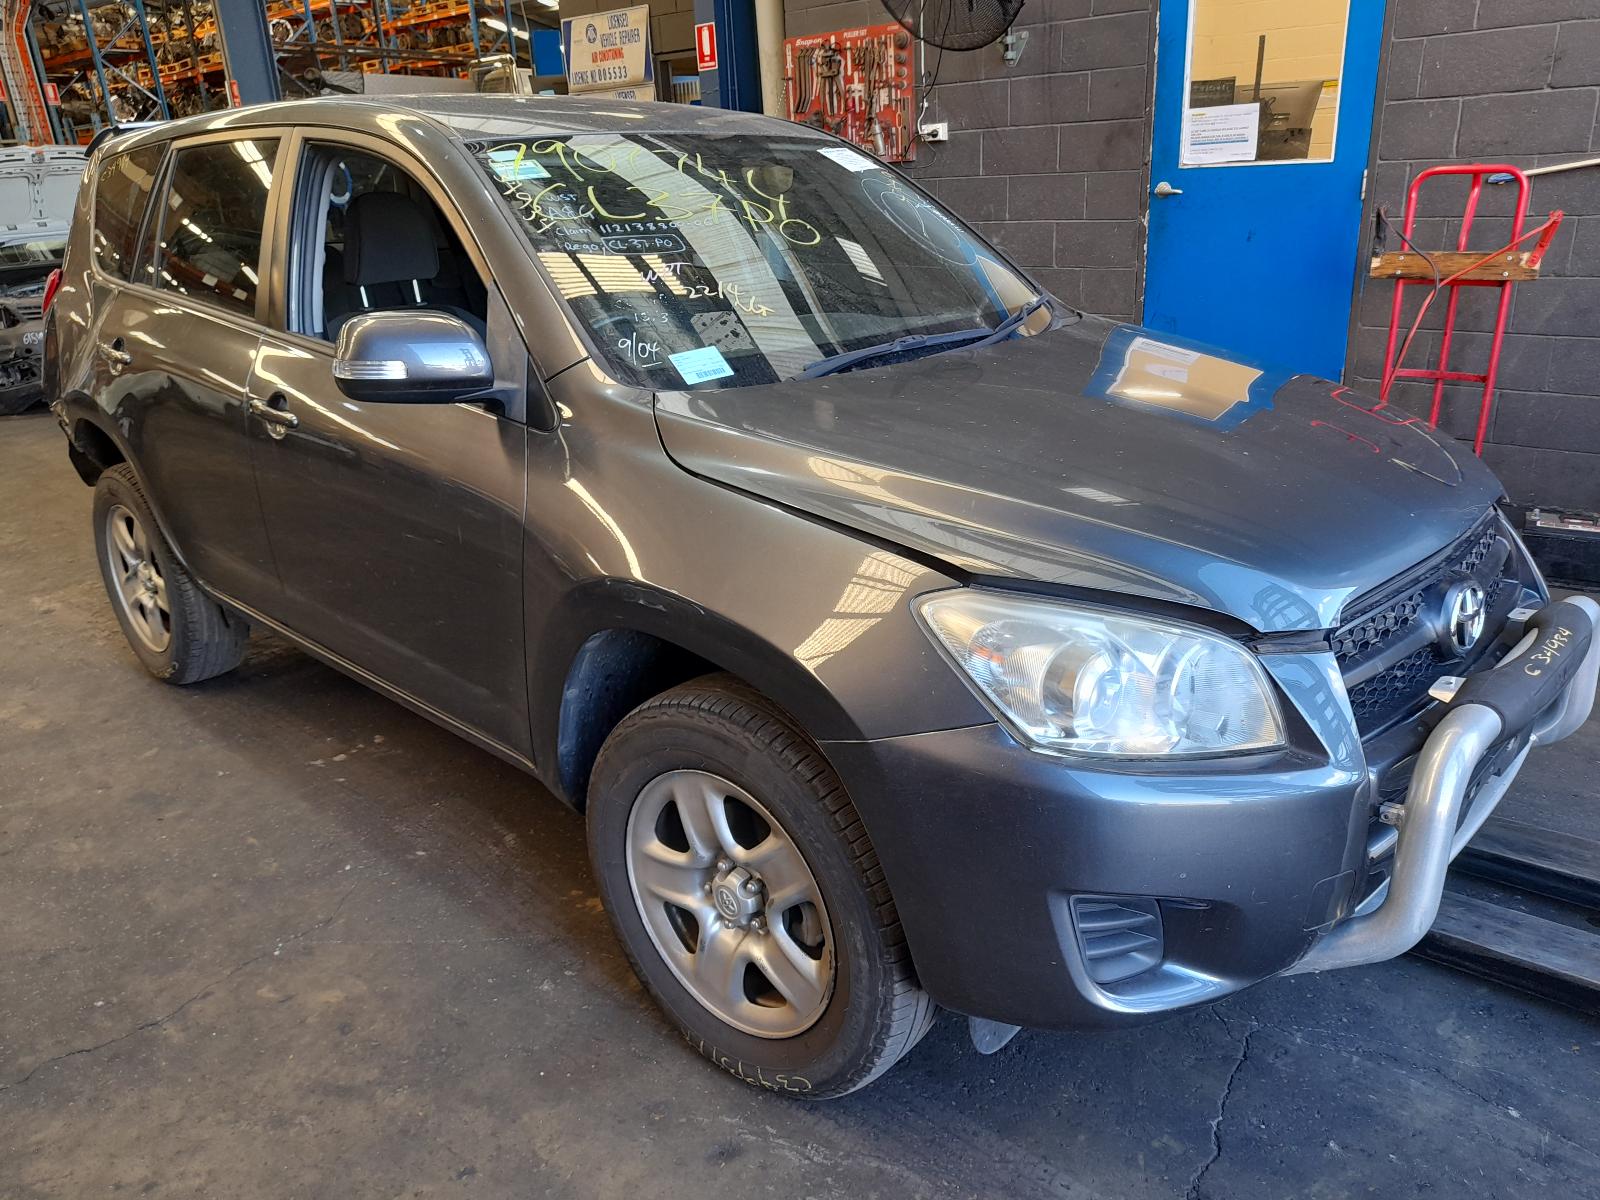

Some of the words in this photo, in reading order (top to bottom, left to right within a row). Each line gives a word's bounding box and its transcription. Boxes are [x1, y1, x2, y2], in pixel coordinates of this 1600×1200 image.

[600, 31, 618, 48] VEHICLE
[619, 28, 641, 46] REPAIRER
[796, 38, 823, 47] Snap-on
[618, 332, 661, 366] 9/04
